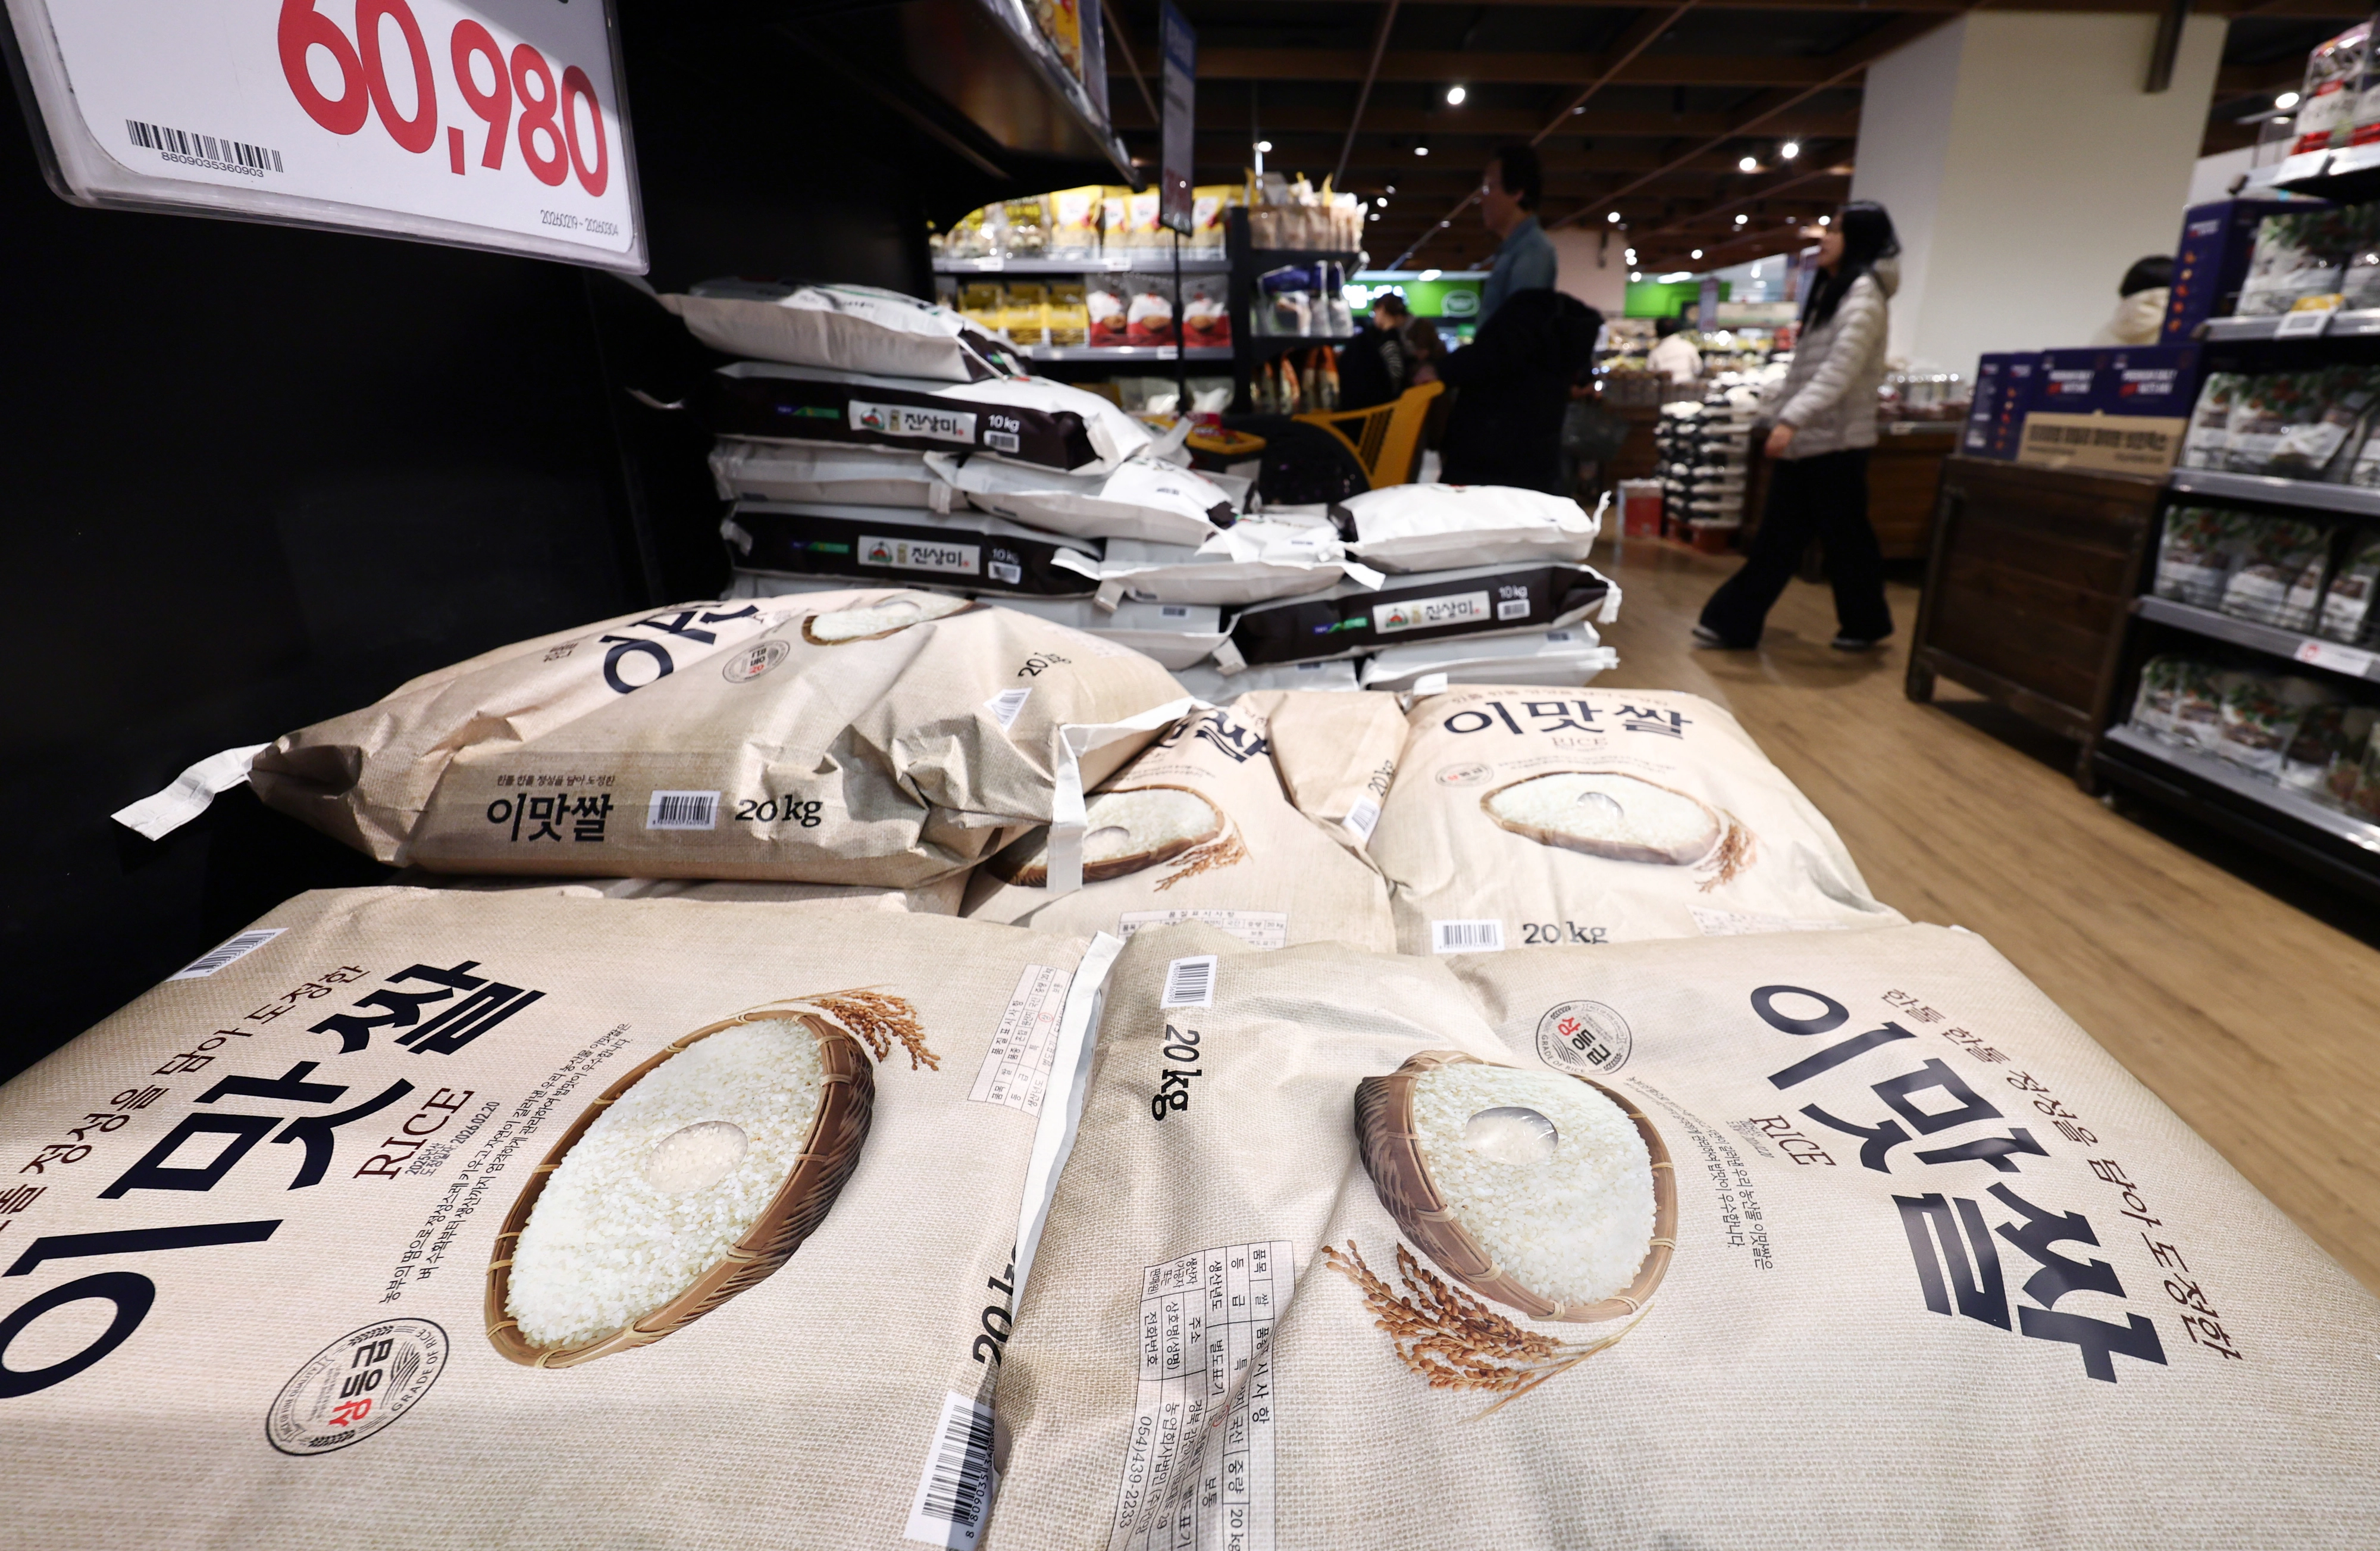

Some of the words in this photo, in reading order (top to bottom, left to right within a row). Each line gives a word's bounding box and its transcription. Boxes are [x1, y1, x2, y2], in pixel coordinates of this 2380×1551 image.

[277, 0, 607, 196] 60,980
[161, 151, 264, 178] 8809035360903
[904, 413, 958, 436] 진상미
[911, 546, 963, 566] 진상미
[1017, 658, 1048, 677] 20
[1443, 699, 1693, 740] 이맛쌀
[1367, 776, 1389, 798] 20
[486, 793, 613, 842] 이맛쌀
[735, 799, 779, 823] 20
[782, 795, 823, 828] kg
[1523, 923, 1562, 945] 20
[1567, 920, 1610, 945] kg
[581, 1037, 634, 1072] 우수합니다.
[991, 1085, 1007, 1100] 품목
[1007, 1047, 1021, 1061] 품종
[1014, 1030, 1028, 1042] 혼합
[1028, 997, 1041, 1008] 국산
[1163, 1024, 1201, 1063] 20
[1541, 1034, 1552, 1061] GRADE
[1552, 1059, 1564, 1068] OF
[18, 1084, 171, 1175] 정성을
[151, 1027, 254, 1076] 담아
[243, 964, 372, 1025] 도정한
[552, 1072, 588, 1096] 밥맛이
[1027, 1078, 1044, 1109] 생산년도
[1151, 1069, 1202, 1121] kg
[352, 1087, 475, 1180] RICE
[449, 1101, 500, 1145] 2026.02.20
[518, 1097, 562, 1136] 관리하여
[485, 1136, 529, 1174] 엄격하게
[1748, 1115, 1838, 1167] RICE
[0, 960, 547, 1399] 이맛쌀
[378, 1265, 416, 1304] 농부의
[400, 1227, 435, 1263] 땀으로
[425, 1182, 470, 1226] 정성스레
[458, 1149, 493, 1180] 키우고
[484, 1120, 521, 1149] 자연이
[512, 1090, 547, 1118] 길러낸
[540, 1072, 566, 1090] 우리
[559, 1049, 594, 1072] 농산물
[589, 1022, 632, 1050] 이맛쌀은
[1708, 1163, 1732, 1192] 밥맛이
[1731, 1168, 1753, 1188] 우리
[1880, 987, 1947, 1024] 한톨
[1940, 1025, 2011, 1065] 한톨
[2005, 1068, 2099, 1147] 정성을
[2087, 1158, 2164, 1228] 담아
[2140, 1231, 2244, 1362] 도정한
[454, 1175, 497, 1218] 생산까지
[1750, 984, 2169, 1385] 이맛쌀
[1717, 1194, 1745, 1249] 우수합니다.
[1739, 1190, 1764, 1222] 농산물
[425, 1219, 467, 1265] 수확부터
[1749, 1222, 1773, 1271] 이맛쌀은
[416, 1266, 440, 1281] 벼
[1160, 1268, 1173, 1287] 또는
[1172, 1259, 1185, 1289] (가공자
[1185, 1257, 1198, 1285] 생산자
[1230, 1258, 1245, 1269] 등
[1253, 1249, 1267, 1274] 품목
[1147, 1267, 1161, 1295] 판매원)
[1208, 1259, 1223, 1312] 생산년도
[1232, 1294, 1246, 1308] 급
[1255, 1293, 1270, 1307] 쌀
[415, 1327, 437, 1350] RICE
[972, 1305, 1013, 1368] 20
[1144, 1311, 1158, 1368] 전화번호
[1165, 1300, 1181, 1371] 상호명(성명)
[1188, 1316, 1201, 1344] 주소
[426, 1349, 440, 1365] OF
[1210, 1339, 1226, 1396] 별도표기
[1233, 1358, 1248, 1371] 특
[391, 1368, 434, 1412] GRADE
[1186, 1399, 1203, 1425] 경북
[1151, 1401, 1180, 1487] 농업회사법인
[1228, 1416, 1244, 1444] 국산
[1119, 1415, 1153, 1529] 054)439-2233
[1227, 1459, 1244, 1495] 중량
[1202, 1477, 1217, 1508] 보통
[1229, 1509, 1244, 1529] 20
